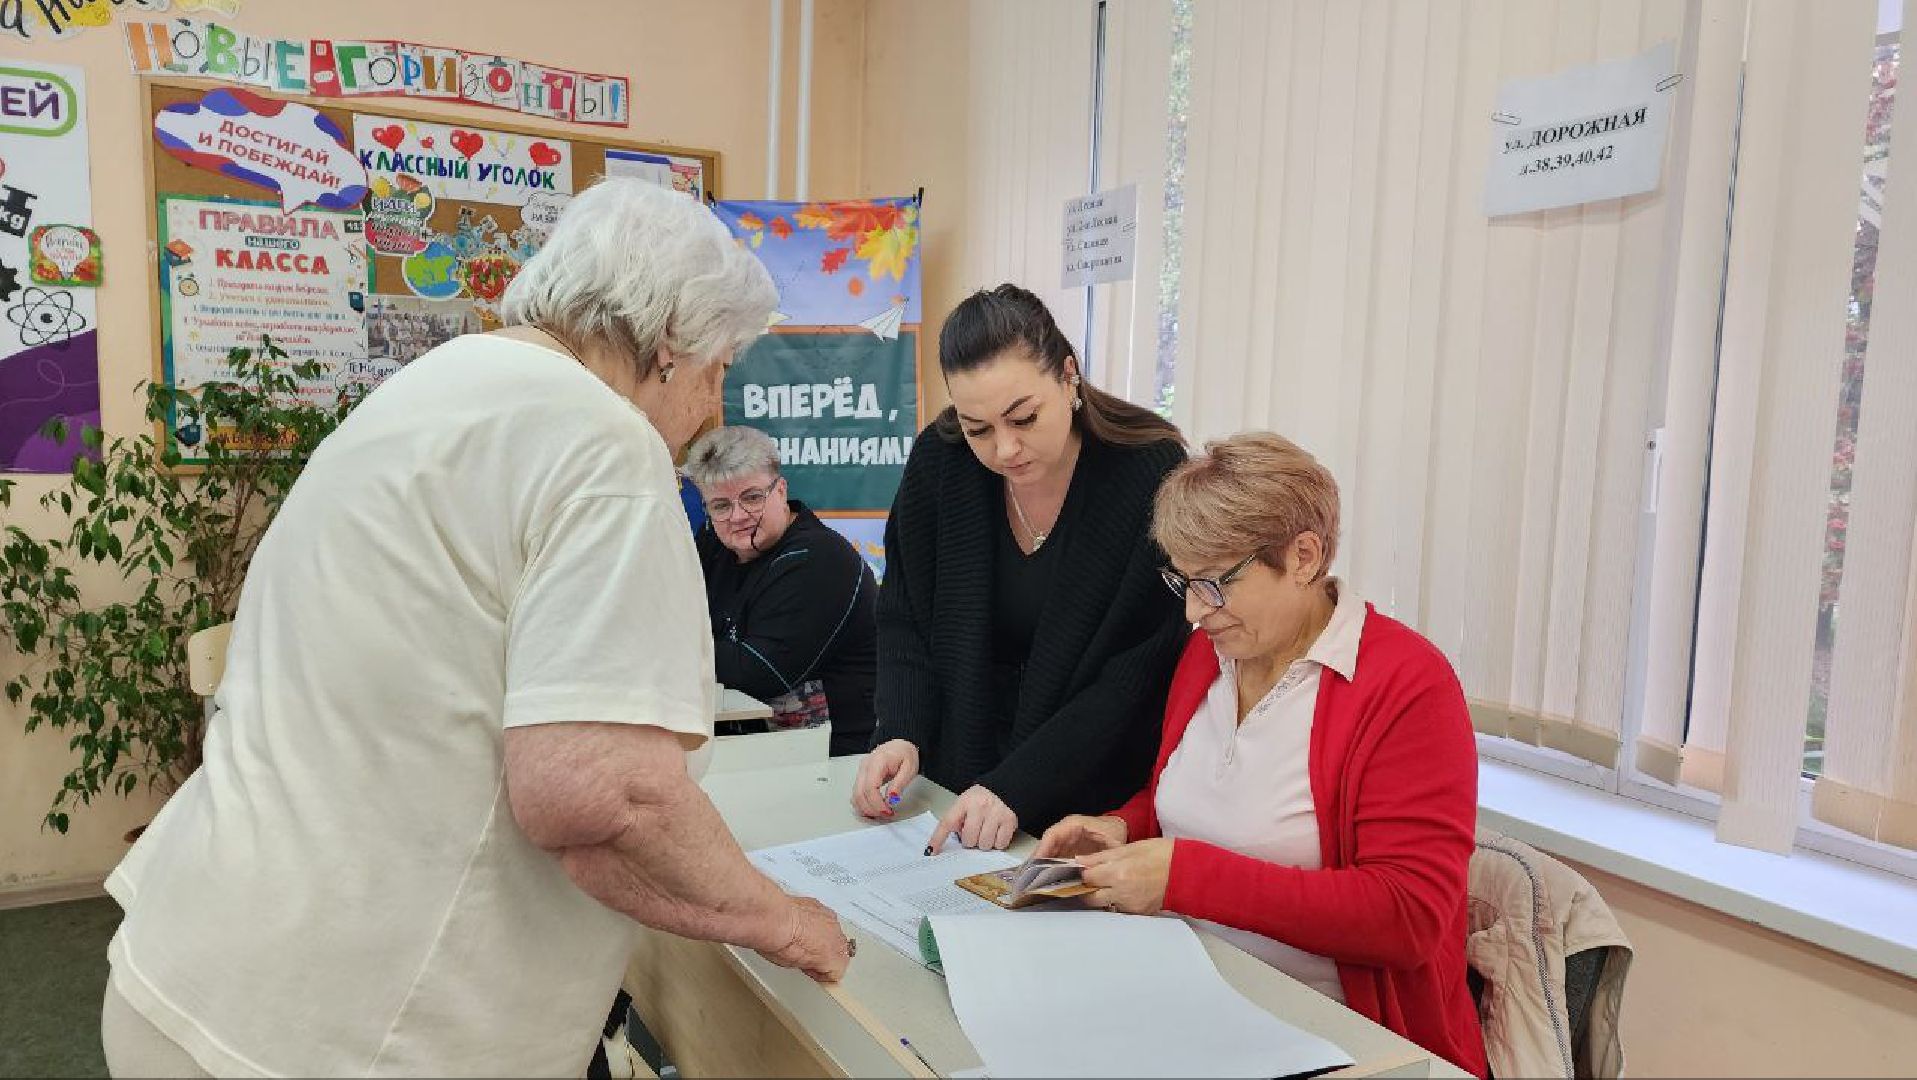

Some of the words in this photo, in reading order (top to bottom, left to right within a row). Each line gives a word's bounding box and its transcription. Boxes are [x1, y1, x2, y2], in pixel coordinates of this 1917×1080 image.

[126, 22, 306, 91] НОВЫЕ
[335, 45, 620, 121] ГОРИЗОНТЫ!
[0, 82, 60, 120] ЕЙ
[218, 118, 330, 167] ДОСТИГАЙ
[1502, 139, 1525, 155] ул.
[1527, 106, 1648, 150] ДОРОЖНАЯ
[198, 132, 212, 147] И
[217, 138, 343, 190] ПОБЕЖДАЙ!
[359, 148, 469, 180] КЛАССНЫЙ
[477, 162, 556, 191] УГОЛОК
[198, 208, 339, 242] ПРАВИЛА
[214, 248, 330, 275] КЛАССА
